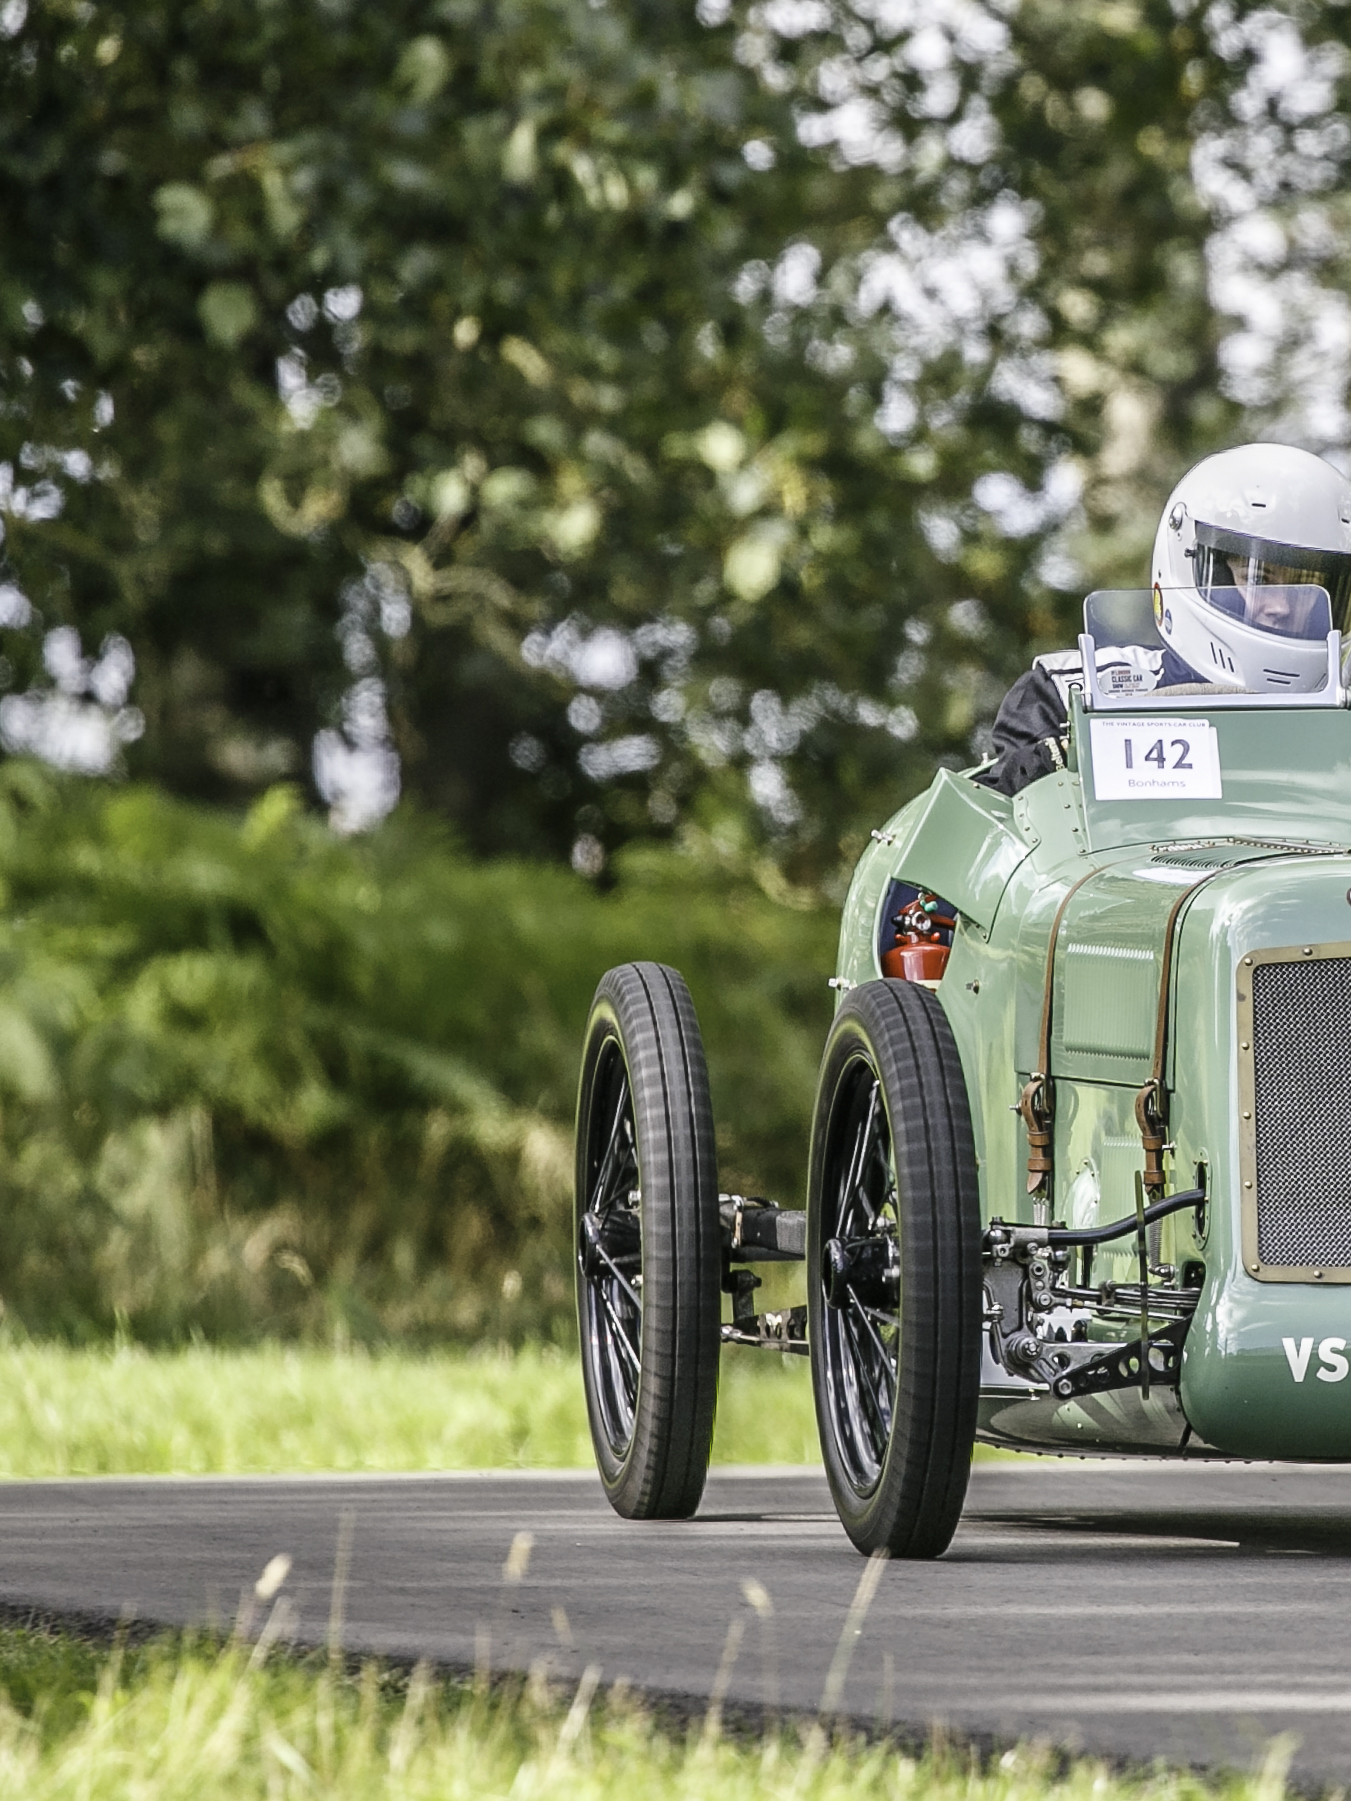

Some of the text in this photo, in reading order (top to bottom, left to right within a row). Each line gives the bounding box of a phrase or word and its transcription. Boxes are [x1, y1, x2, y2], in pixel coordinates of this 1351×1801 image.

[1112, 674, 1143, 683] CLASSIC CAR
[1124, 738, 1194, 770] 142
[1128, 779, 1186, 788] Bonhams
